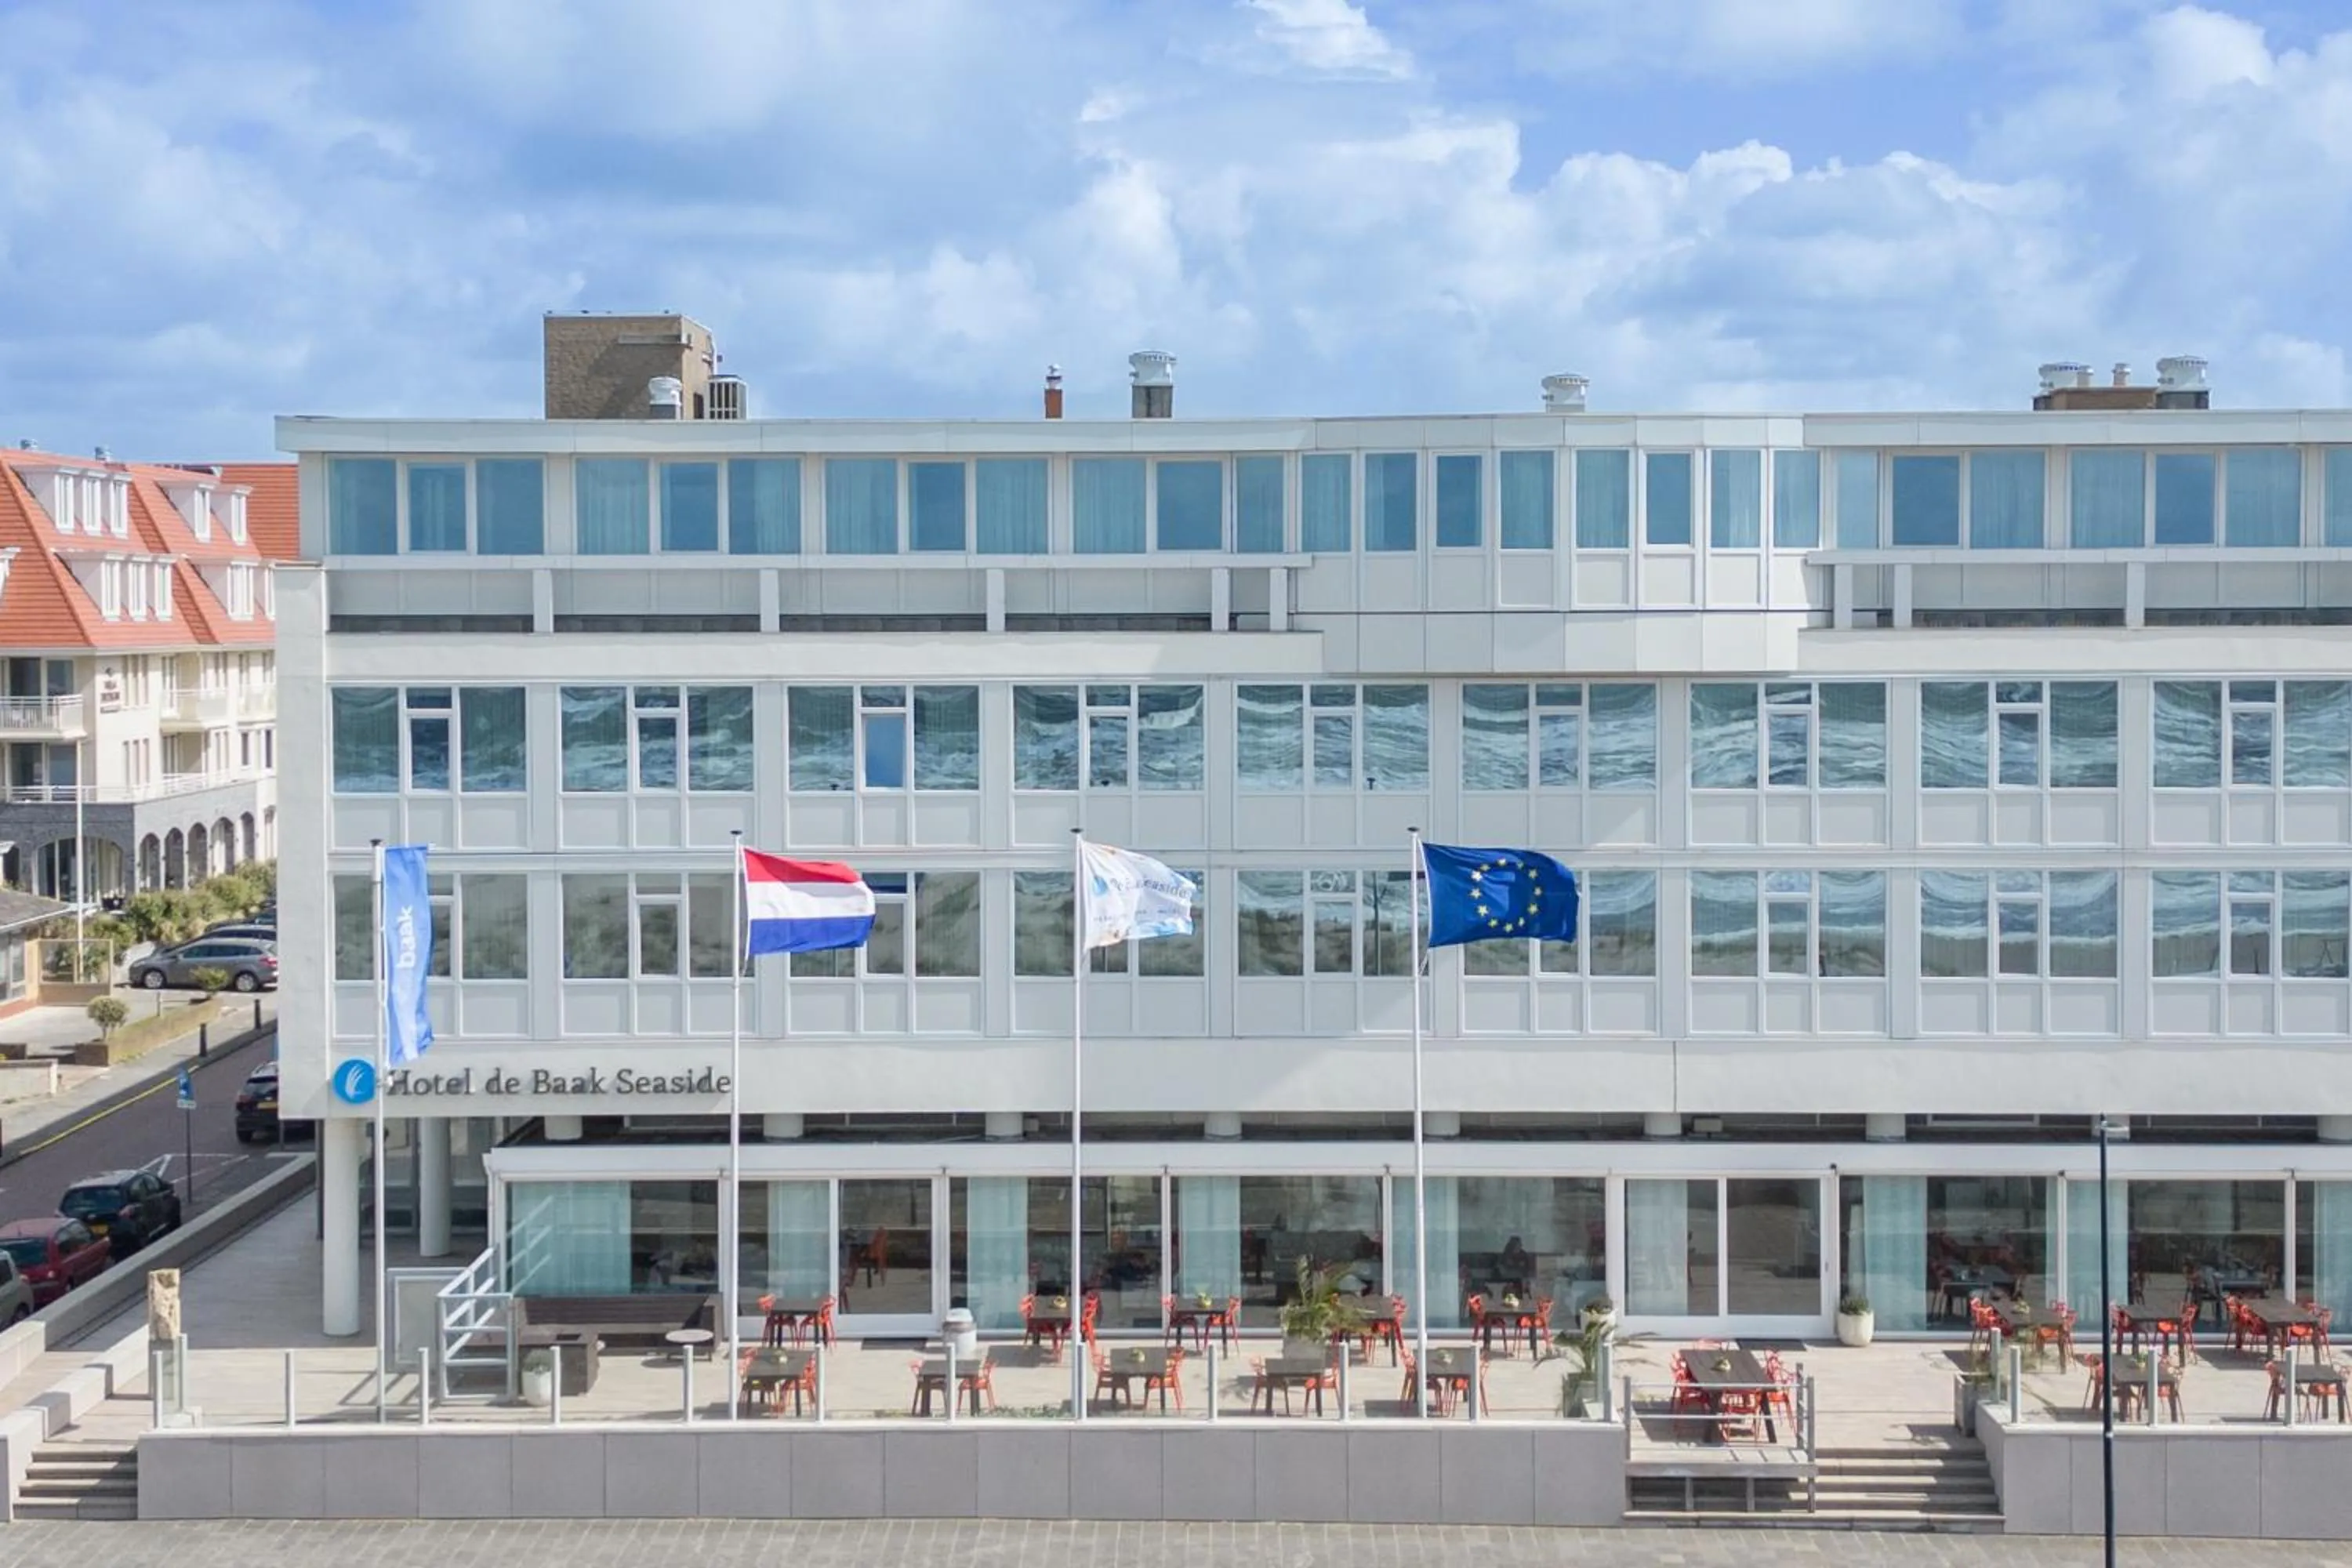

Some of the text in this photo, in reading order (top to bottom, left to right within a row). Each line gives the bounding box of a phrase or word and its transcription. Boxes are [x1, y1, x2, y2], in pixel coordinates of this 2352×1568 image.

[1140, 877, 1191, 898] easide
[396, 905, 416, 967] baak
[387, 1065, 731, 1095] Hotel de Baak Seaside
